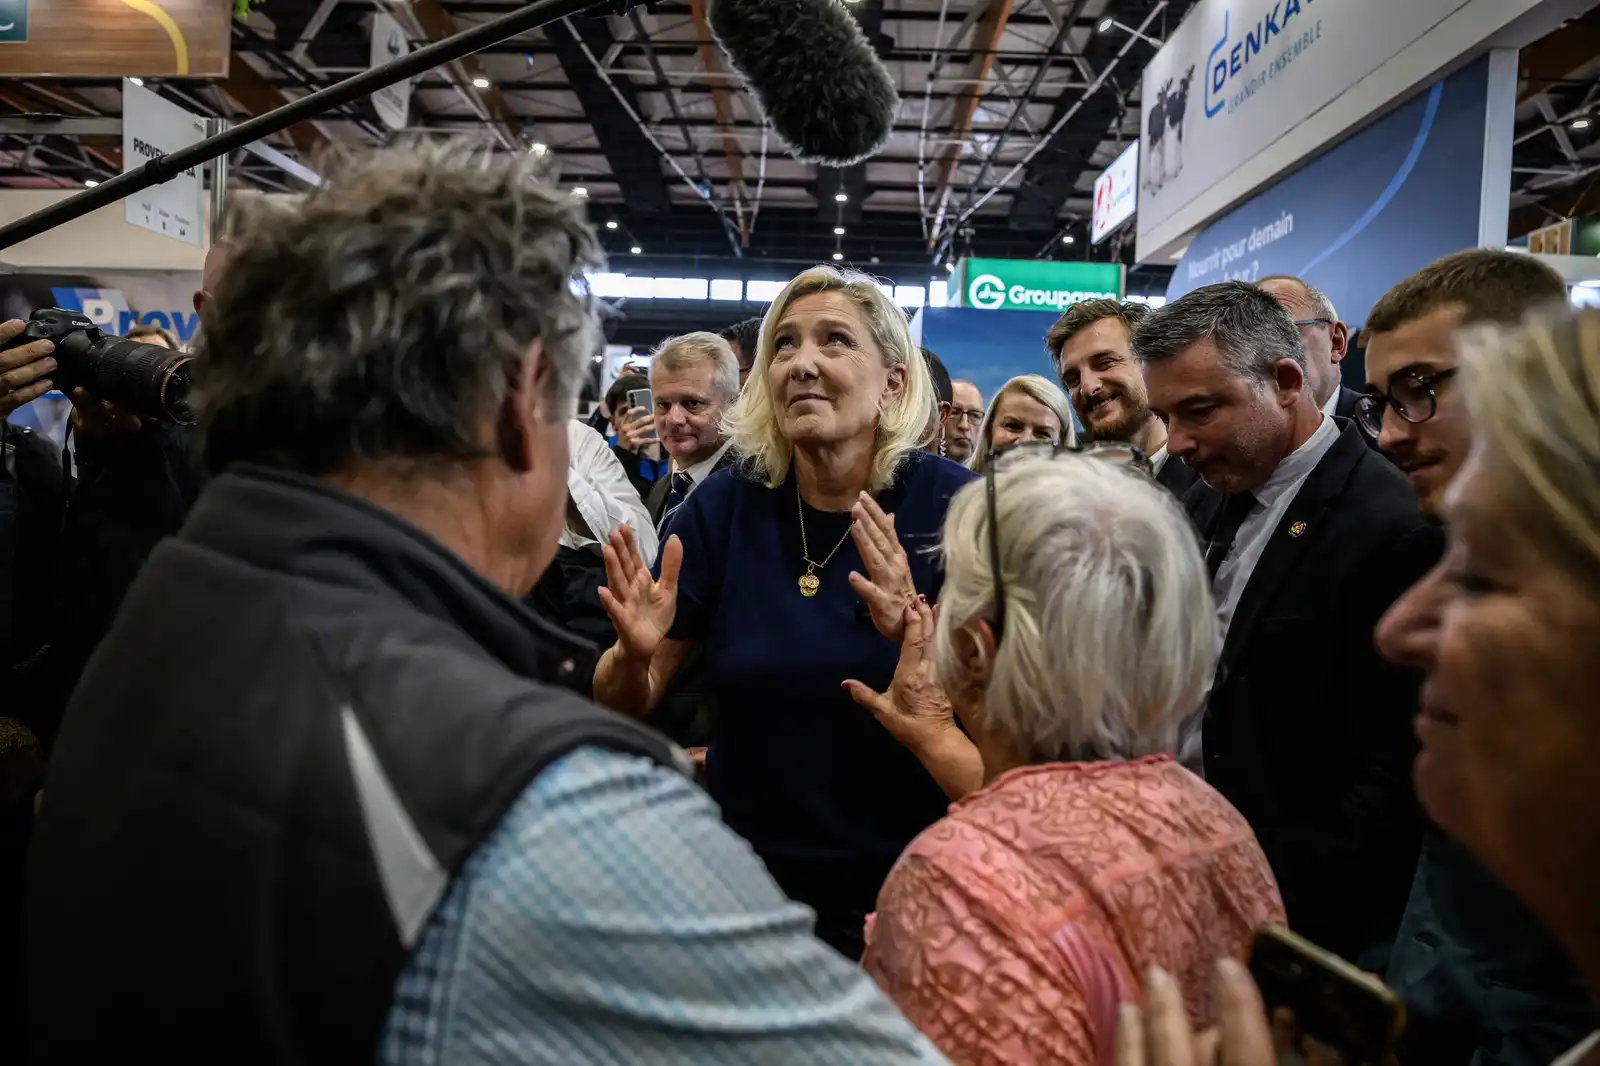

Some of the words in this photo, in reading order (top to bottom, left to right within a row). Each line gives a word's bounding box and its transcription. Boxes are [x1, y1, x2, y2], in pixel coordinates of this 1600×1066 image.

[1213, 0, 1315, 94] DENKA
[1269, 19, 1322, 79] ENSEMBLE
[1221, 238, 1247, 270] pour
[1248, 209, 1293, 252] demain
